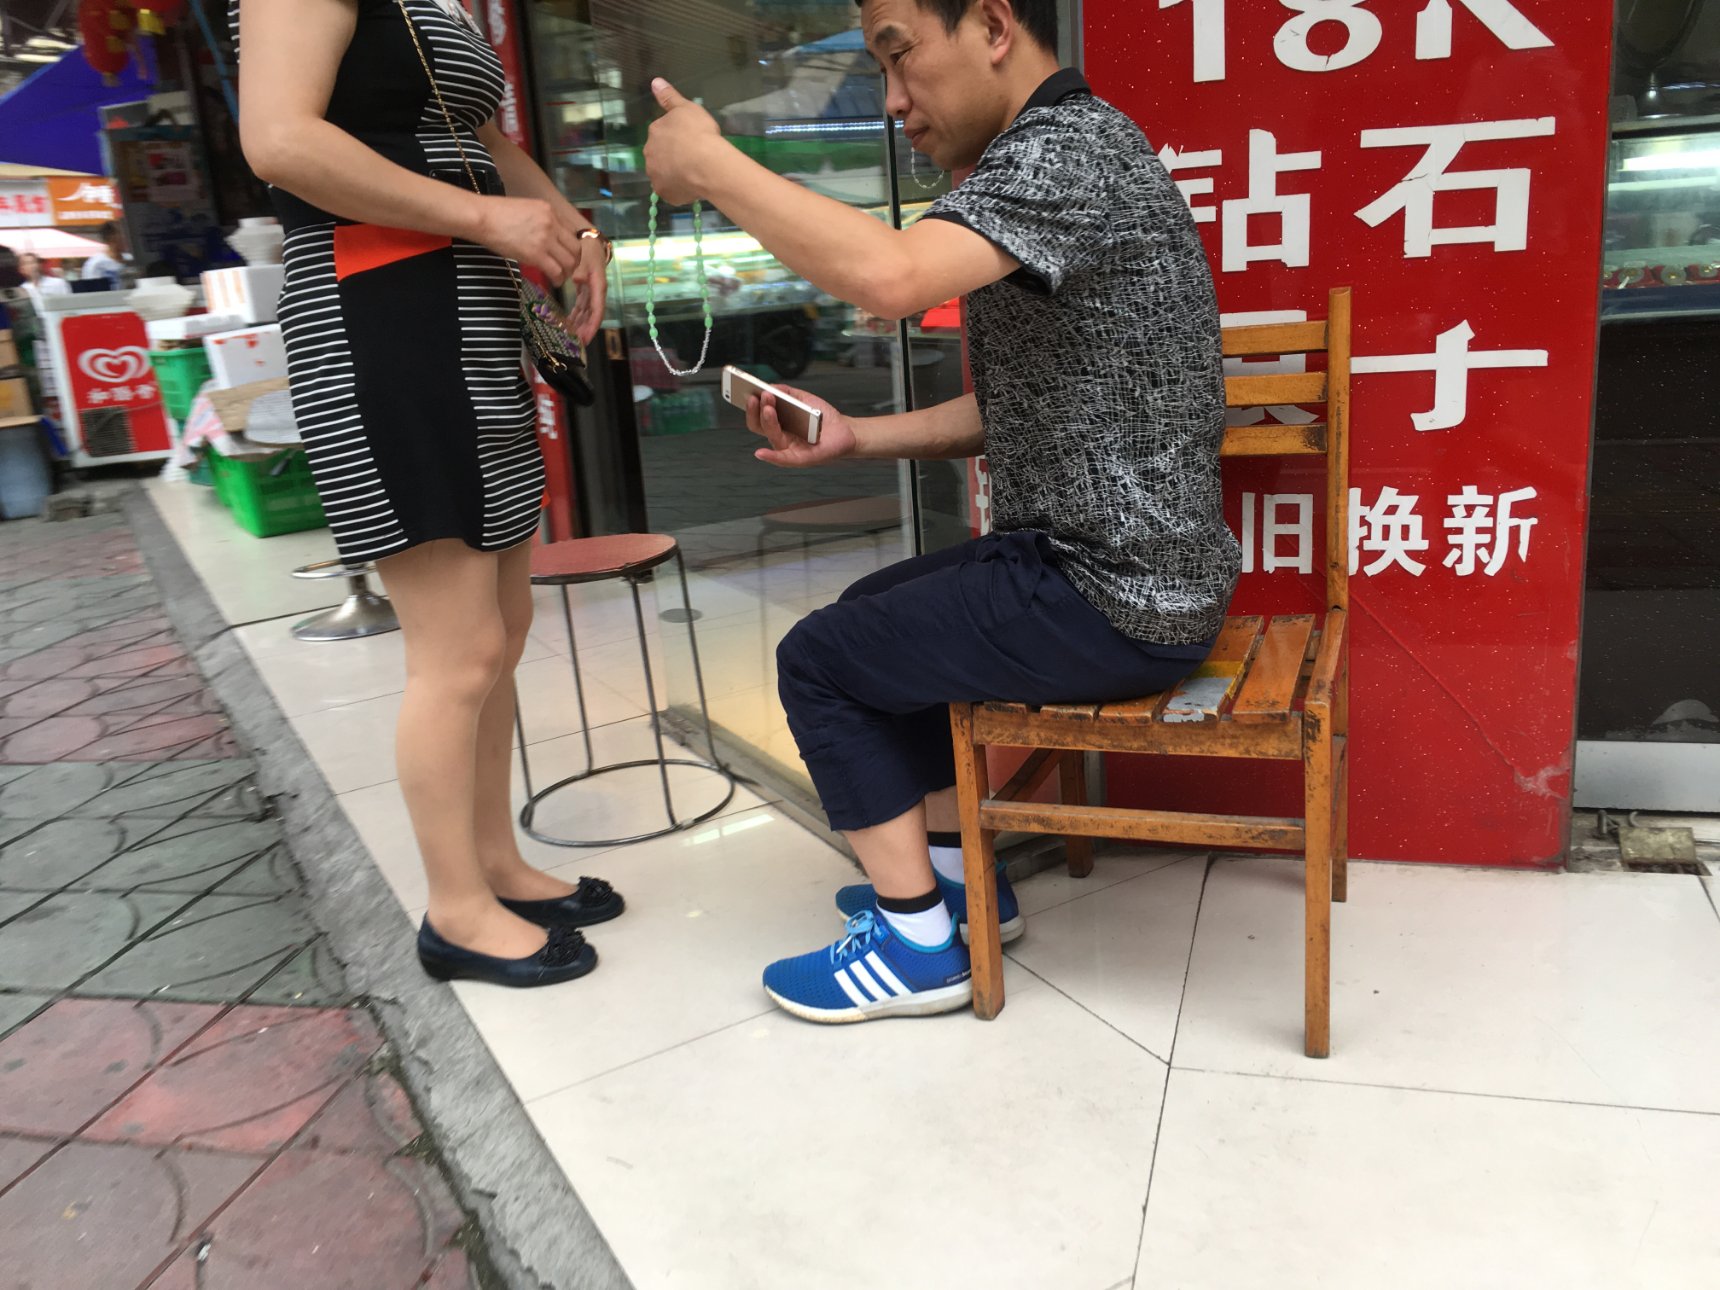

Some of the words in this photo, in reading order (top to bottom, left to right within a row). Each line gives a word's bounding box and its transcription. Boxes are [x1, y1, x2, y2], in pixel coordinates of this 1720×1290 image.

[1158, 116, 1556, 273] 钻石
[1241, 485, 1538, 577] 旧换新
